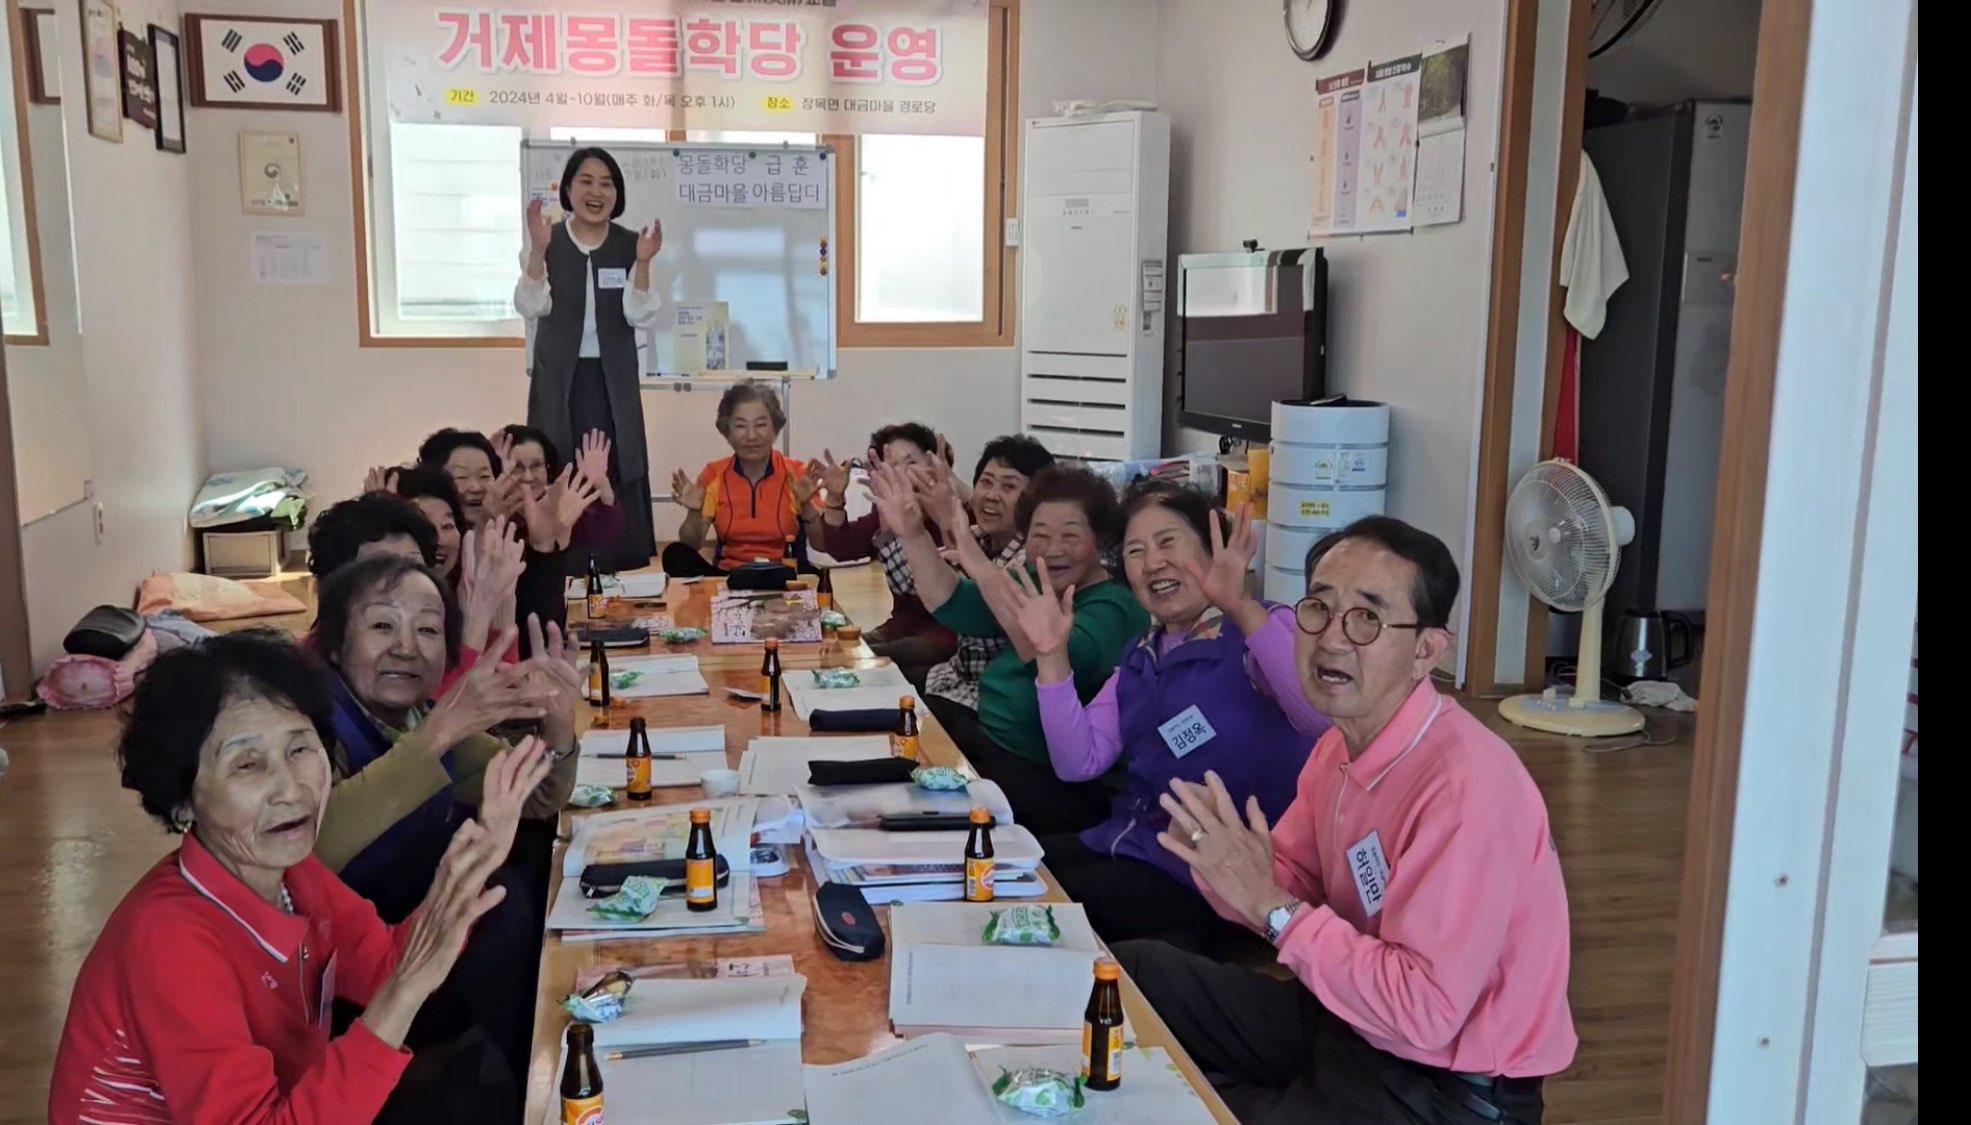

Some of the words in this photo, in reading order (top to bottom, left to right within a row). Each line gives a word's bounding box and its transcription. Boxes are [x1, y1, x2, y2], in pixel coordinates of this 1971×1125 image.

[437, 11, 802, 77] 거제몽돌학당
[830, 22, 938, 81] 운영
[450, 89, 475, 103] 기간
[489, 91, 541, 105] 2024년
[680, 93, 706, 108] 오후
[712, 93, 736, 109] 1시)
[767, 96, 791, 110] 장소
[844, 98, 894, 113] 대금마을
[899, 99, 936, 114] 경로당
[678, 154, 747, 175] 몽돌학당
[765, 154, 782, 175] 급
[792, 155, 810, 175] 훈
[679, 182, 749, 203] 대금마을
[1171, 722, 1208, 750] 김정옥
[1356, 847, 1382, 904] 허일만
